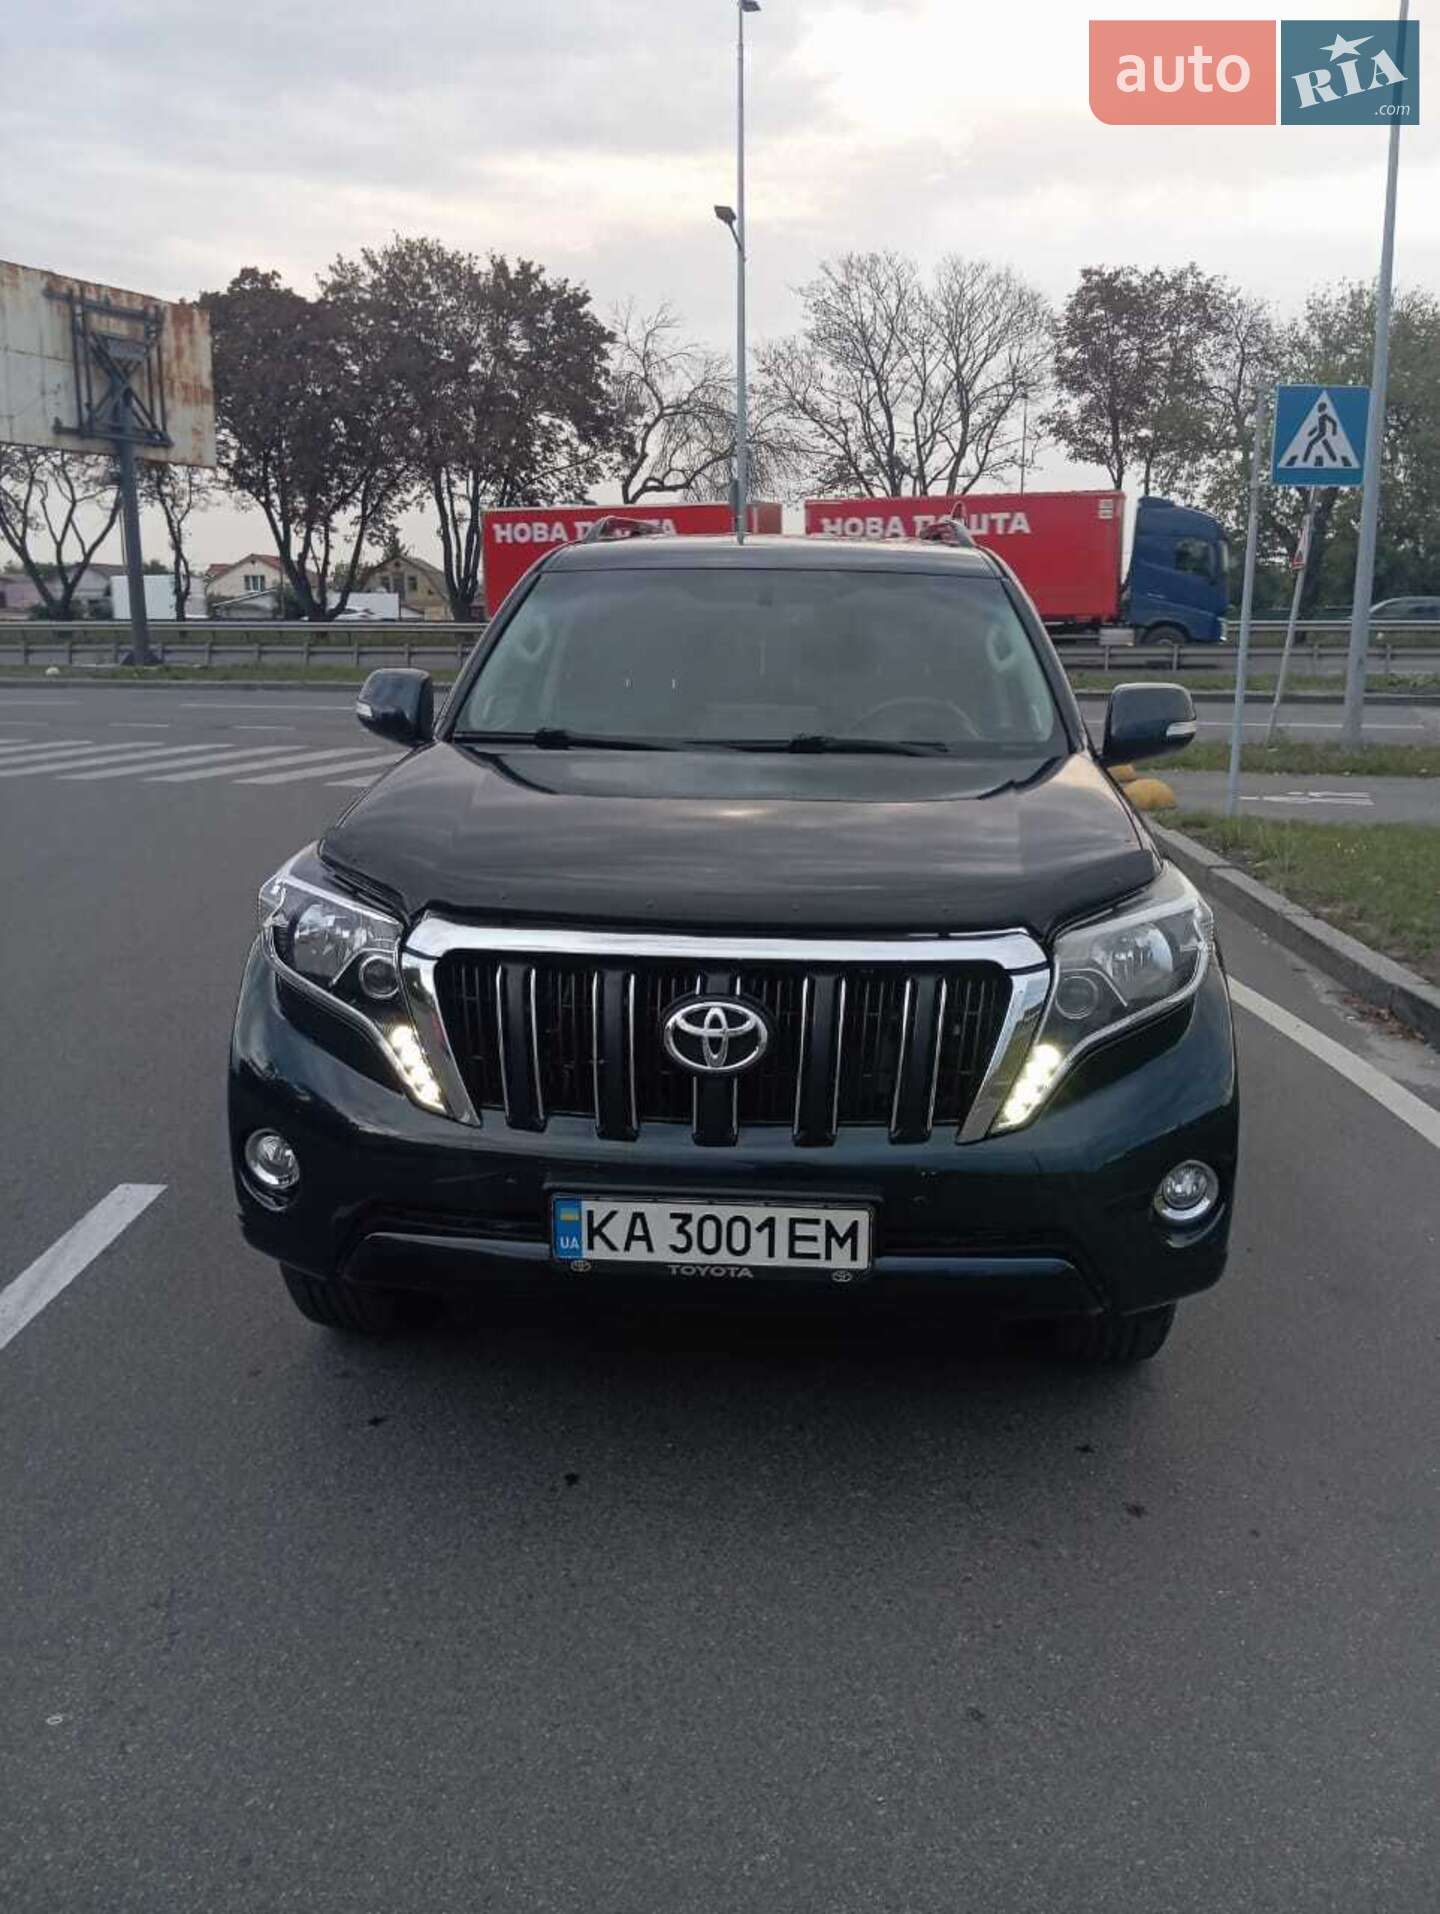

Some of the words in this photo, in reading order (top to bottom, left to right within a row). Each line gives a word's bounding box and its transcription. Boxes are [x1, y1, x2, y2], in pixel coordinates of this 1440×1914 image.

[493, 522, 568, 543] НОВА
[821, 516, 905, 537] НОВА
[586, 1210, 654, 1252] KA
[560, 1236, 580, 1249] UA
[667, 1264, 754, 1279] TOYOTA
